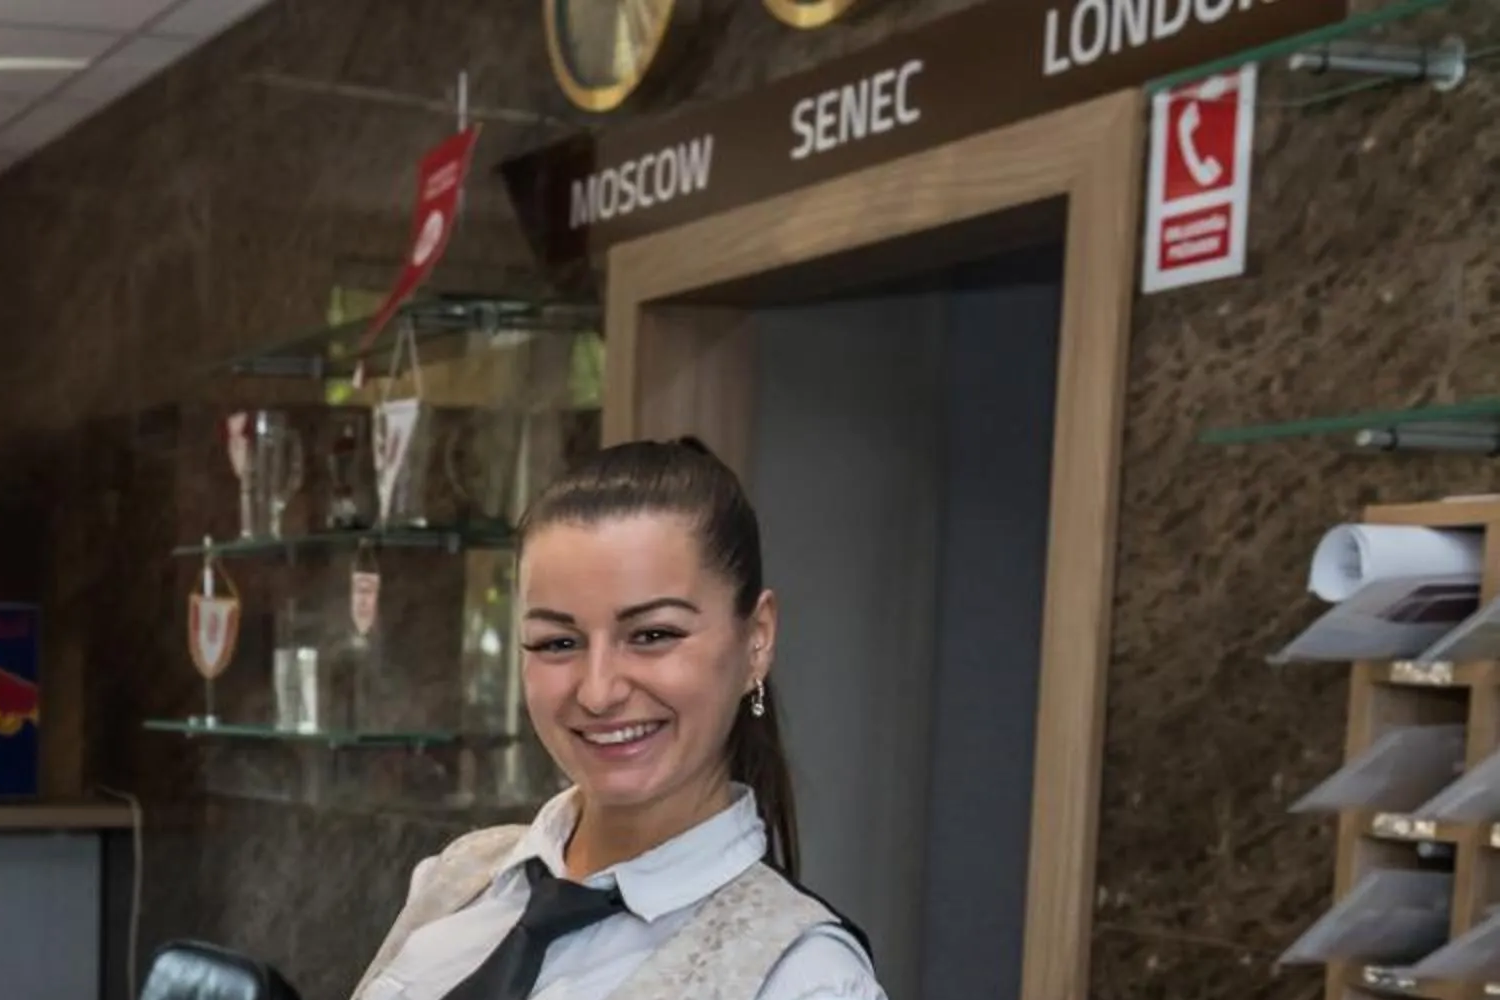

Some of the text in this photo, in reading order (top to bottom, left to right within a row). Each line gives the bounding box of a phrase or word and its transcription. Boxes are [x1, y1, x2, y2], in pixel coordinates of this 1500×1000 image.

[1043, 0, 1280, 75] LOND
[790, 59, 924, 160] SENEC
[569, 134, 713, 229] MOSCOW
